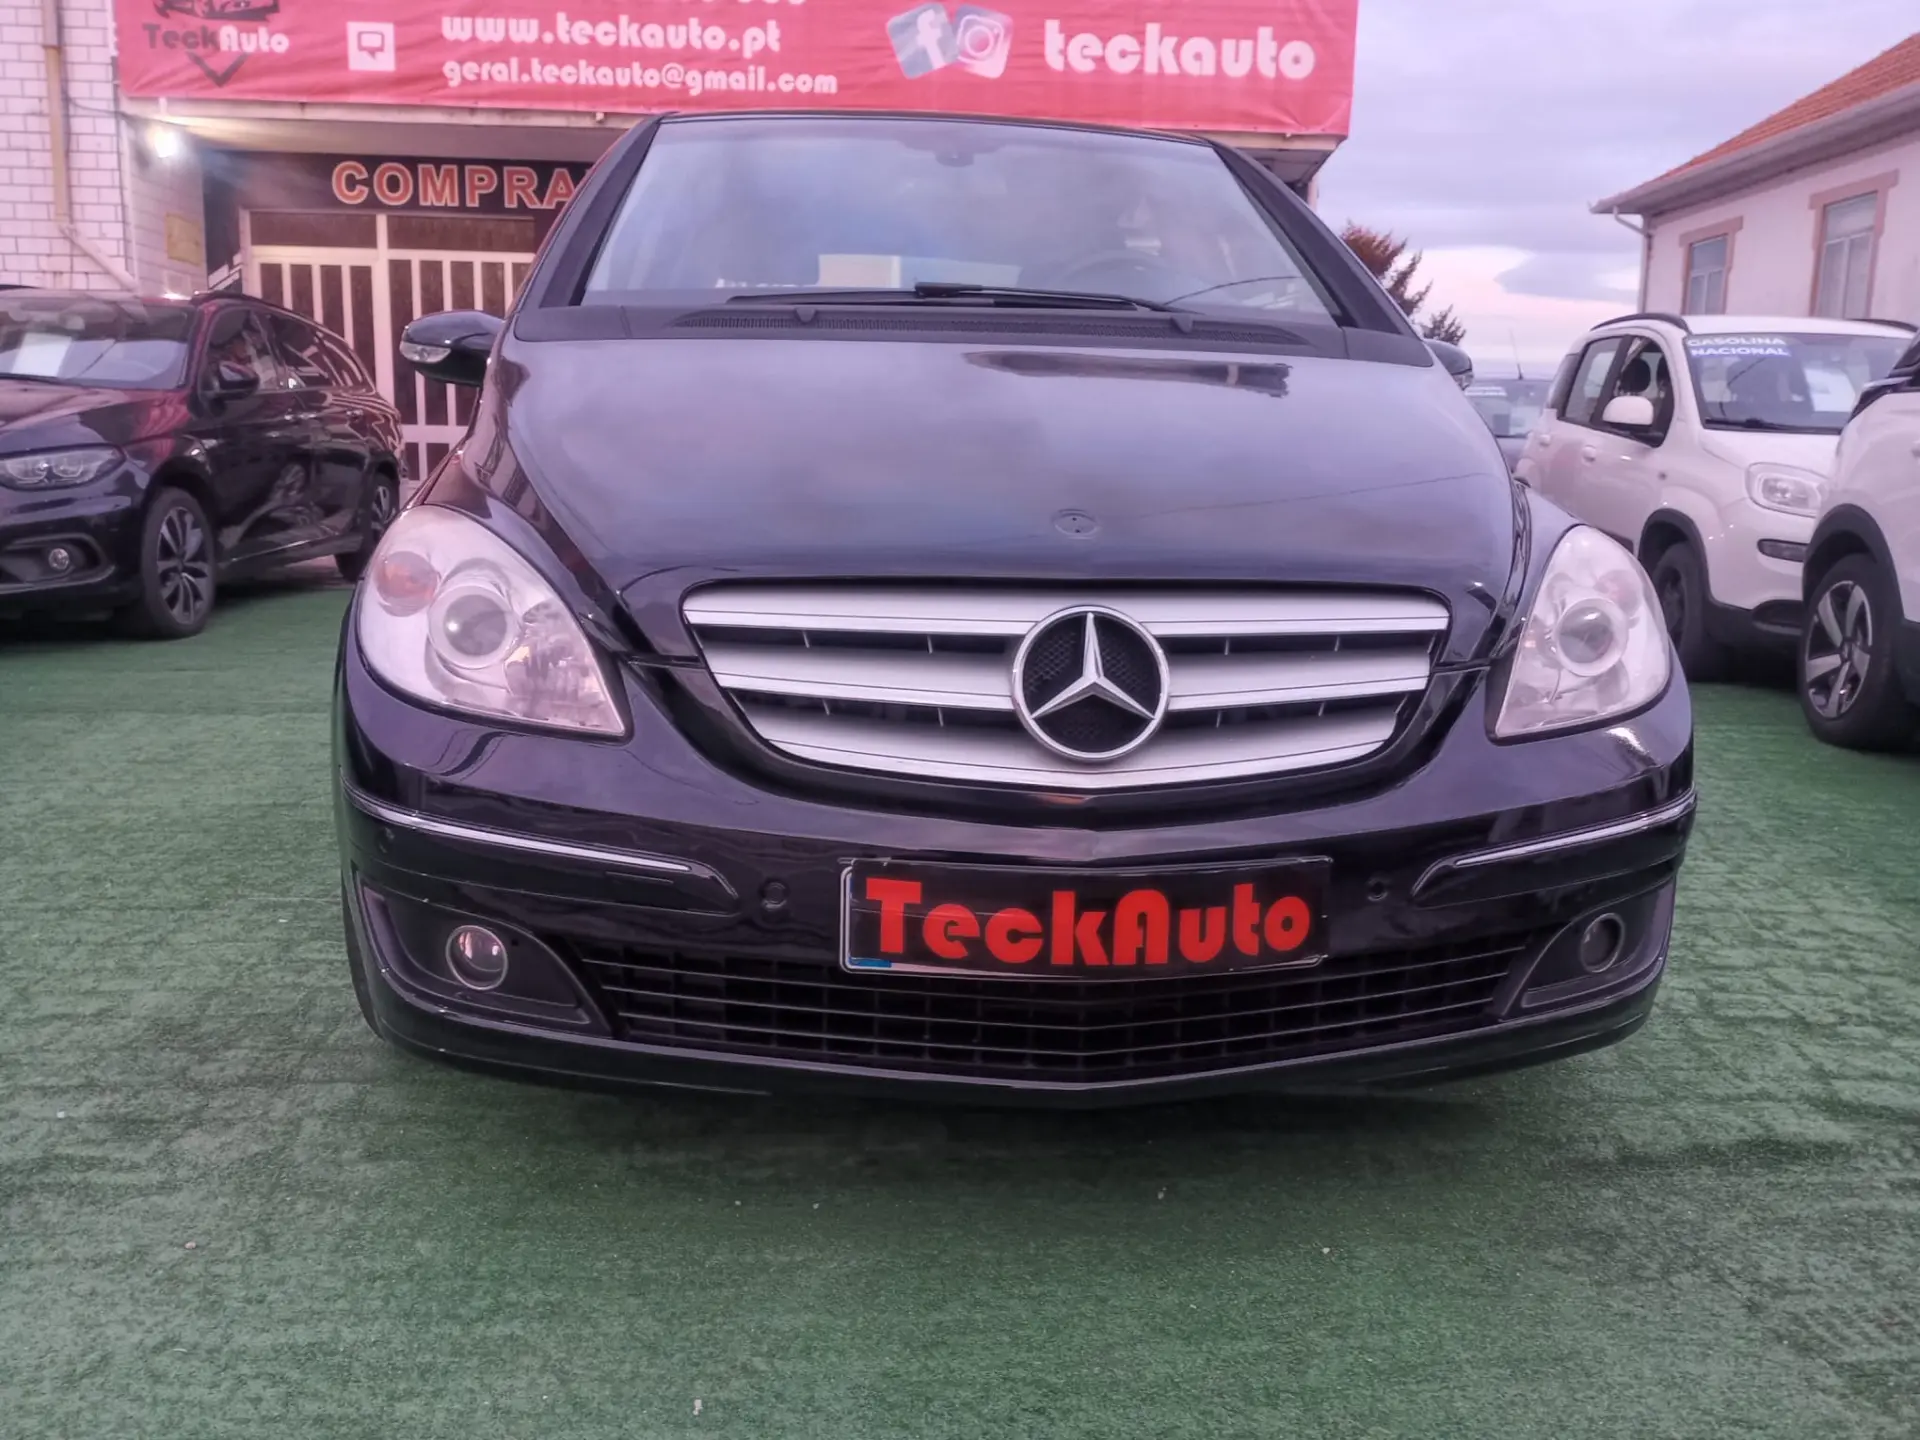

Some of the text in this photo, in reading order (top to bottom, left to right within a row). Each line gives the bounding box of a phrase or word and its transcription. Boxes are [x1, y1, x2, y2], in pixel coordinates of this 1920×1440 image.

[142, 23, 290, 53] TeckAuto
[441, 12, 781, 58] www.teckauto.pt
[1043, 18, 1317, 79] teckauto
[442, 56, 838, 96] geral.teckauto@gmail.com
[1691, 347, 1792, 357] NACIONAL
[865, 877, 1311, 966] TeckAuto
